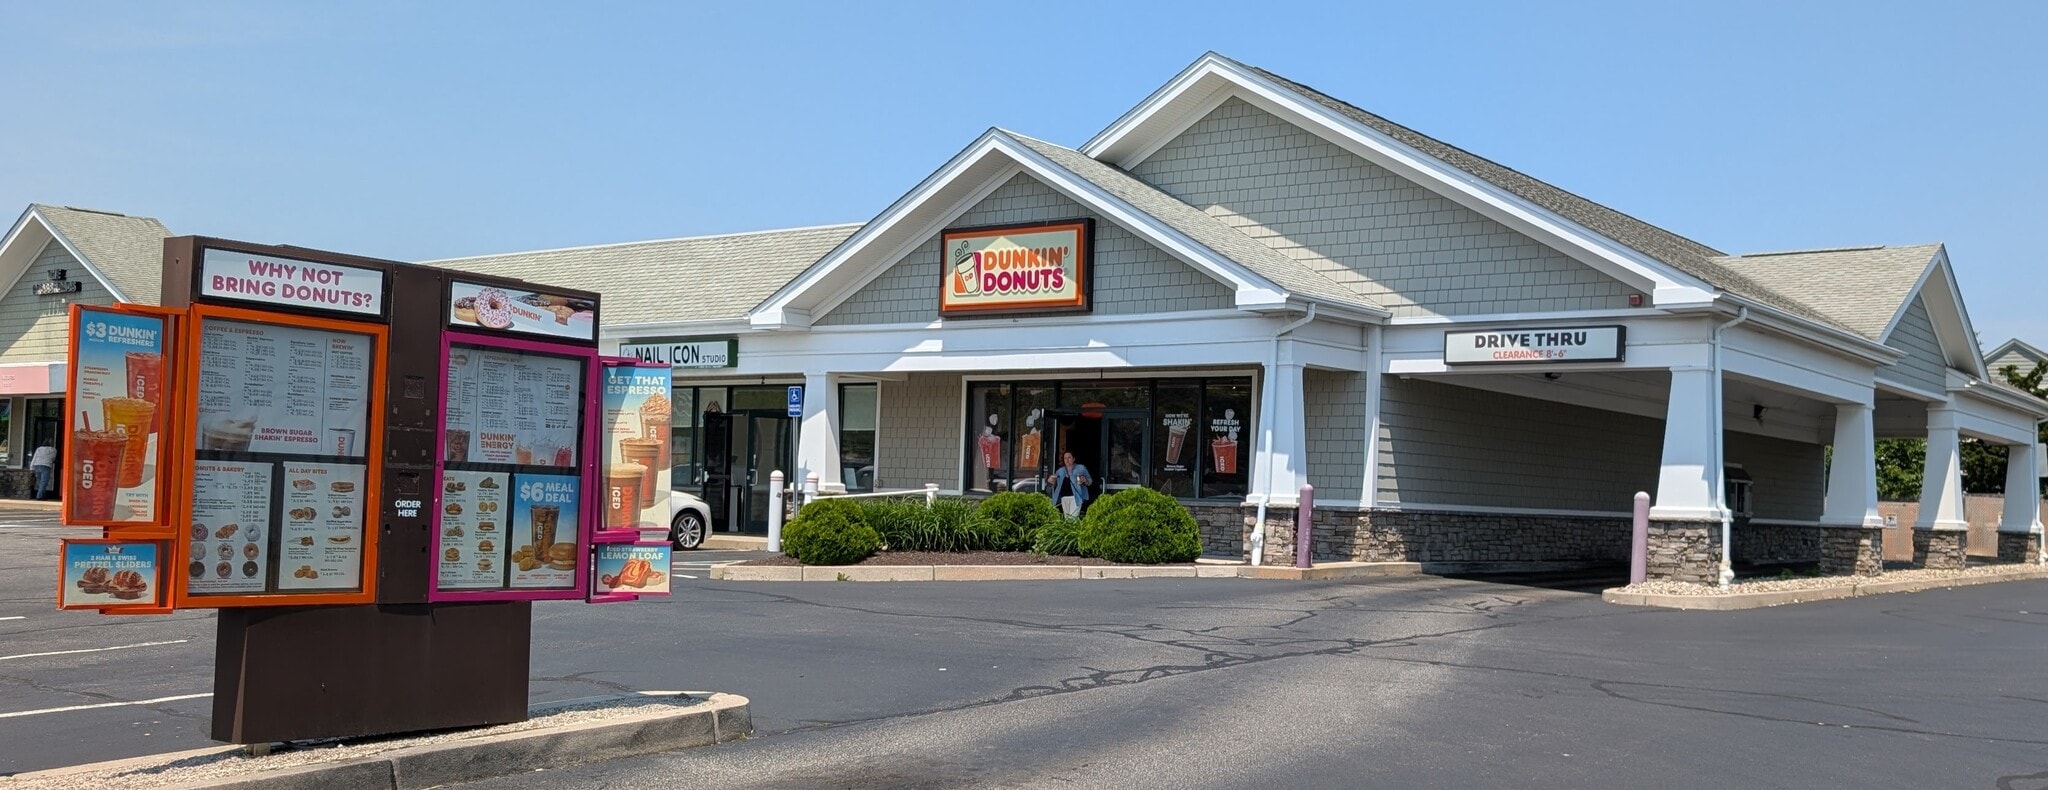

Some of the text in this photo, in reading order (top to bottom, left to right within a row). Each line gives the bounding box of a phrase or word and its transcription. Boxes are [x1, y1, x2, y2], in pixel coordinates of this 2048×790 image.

[984, 246, 1070, 271] DUNKIN'
[249, 260, 343, 286] WHY NOT
[983, 268, 1064, 292] DONUTS
[212, 275, 372, 308] BRING DONUTS?
[512, 306, 542, 321] DUNKIN'
[86, 321, 157, 340] $3 DUNKIN'
[204, 325, 228, 333] COFFEE
[235, 328, 264, 336] ESPRESSO
[108, 336, 154, 347] REFRESHERS
[1475, 332, 1587, 349] DRIVE THRU
[635, 345, 726, 364] NAIL ICON STUDIO
[1493, 349, 1567, 359] CLEARANCE 8'-6"
[608, 375, 666, 385] GET THAT
[136, 375, 146, 398] ICED
[607, 385, 667, 395] ESPRESSO
[116, 424, 126, 434] IC
[261, 427, 288, 435] BROWN
[480, 432, 517, 441] DUNKIN'
[338, 436, 346, 456] DUN
[480, 441, 514, 449] ENERGY
[82, 460, 94, 489] ICED
[520, 481, 574, 502] $6 MEAL
[545, 493, 572, 503] DEAL
[612, 486, 621, 509] ICED
[395, 500, 421, 508] ORDER
[398, 509, 417, 518] HERE
[601, 552, 664, 560] LEMON LOAF
[74, 560, 152, 569] PRETZEL SLIDERS
